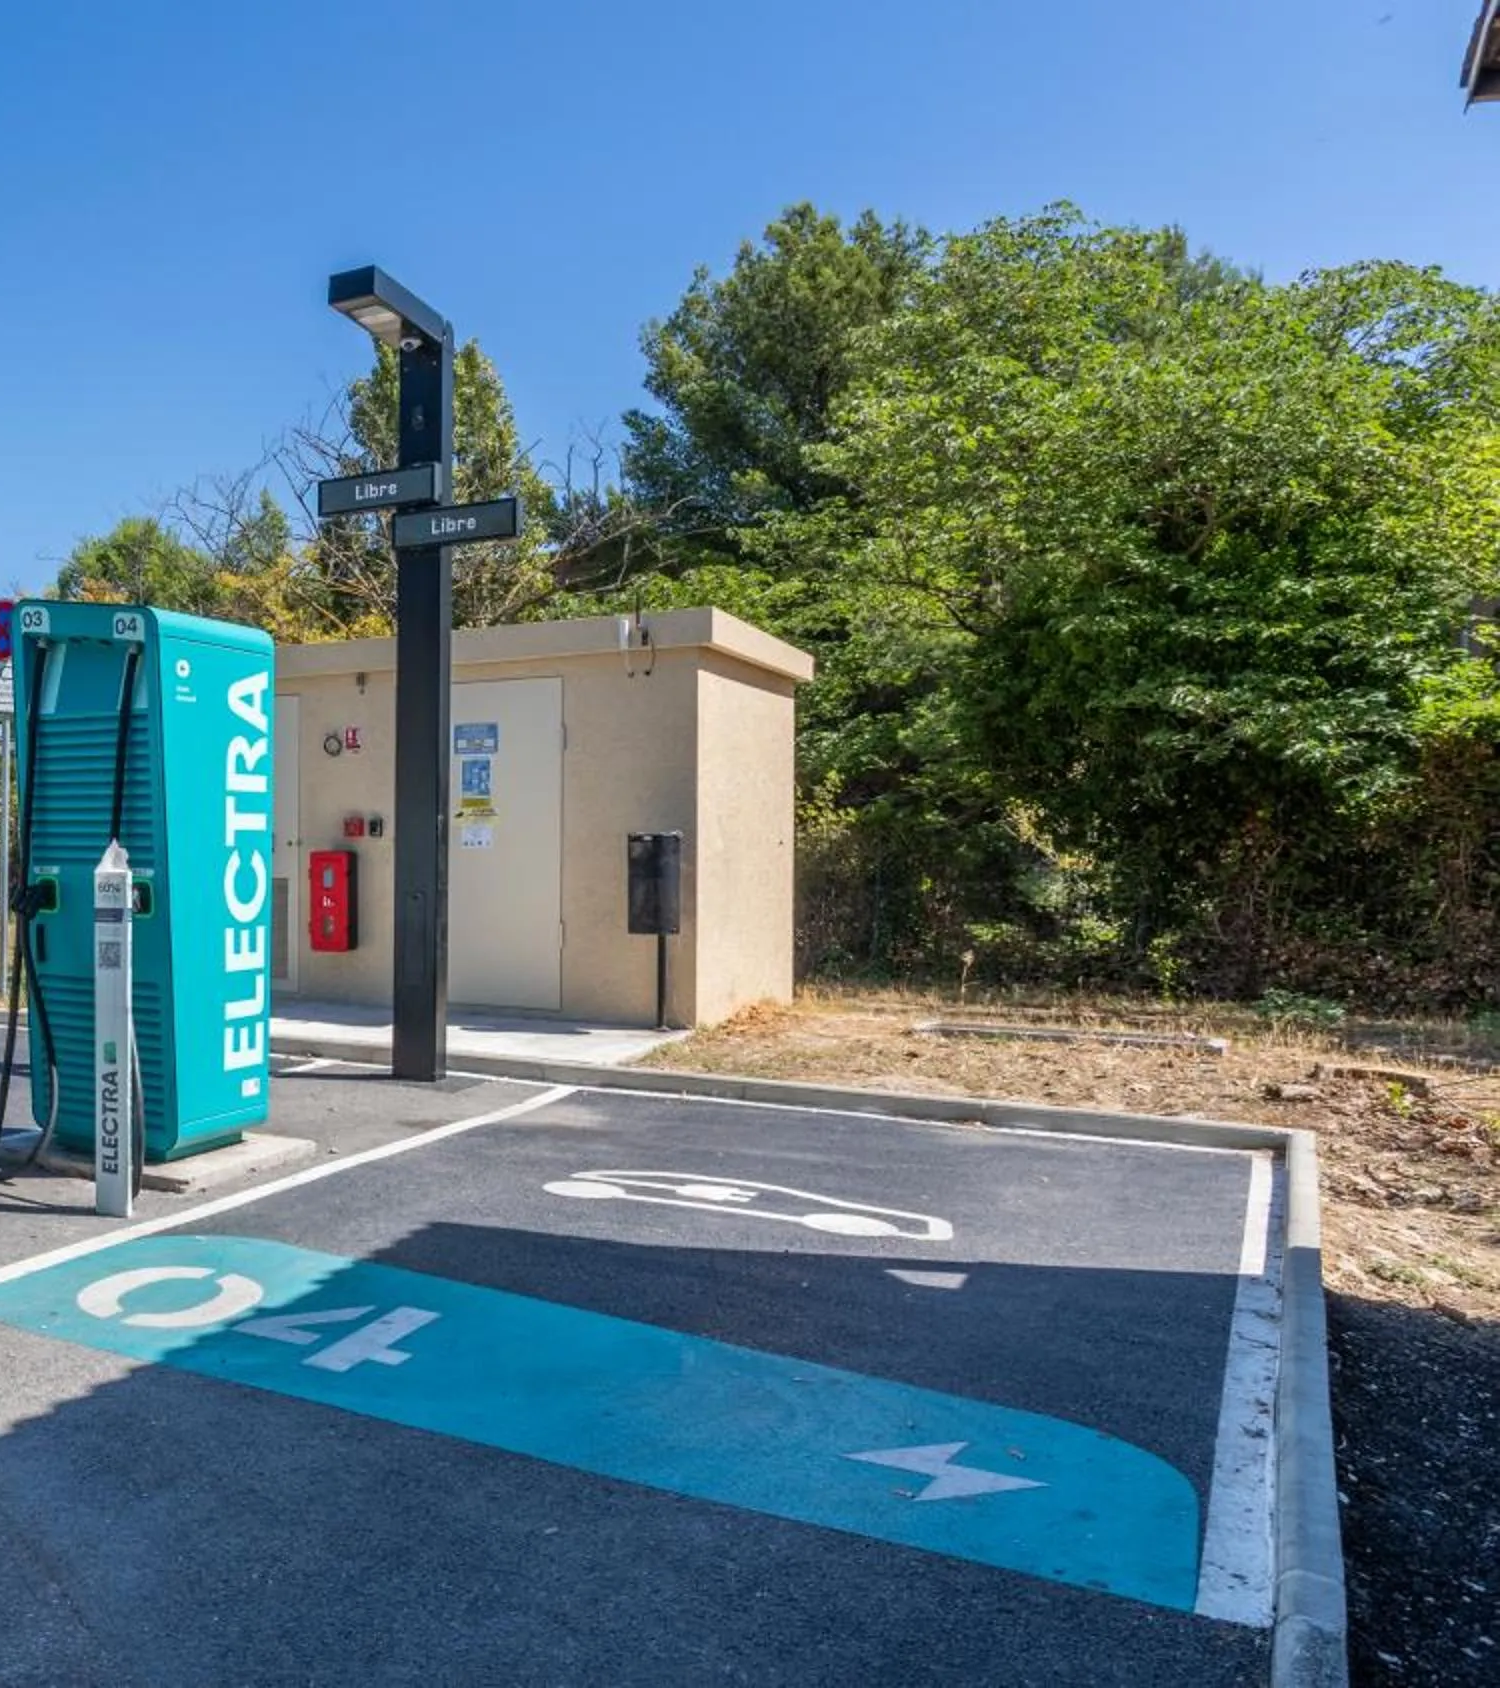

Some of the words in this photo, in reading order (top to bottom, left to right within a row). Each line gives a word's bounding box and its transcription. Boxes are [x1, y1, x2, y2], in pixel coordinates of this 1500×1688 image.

[355, 483, 397, 500] Libre
[431, 517, 477, 535] Libre
[22, 611, 43, 628] 03
[115, 617, 138, 635] 04
[224, 671, 269, 1072] ELECTRA
[101, 1071, 119, 1174] ELECTRA
[76, 1265, 443, 1373] 04
